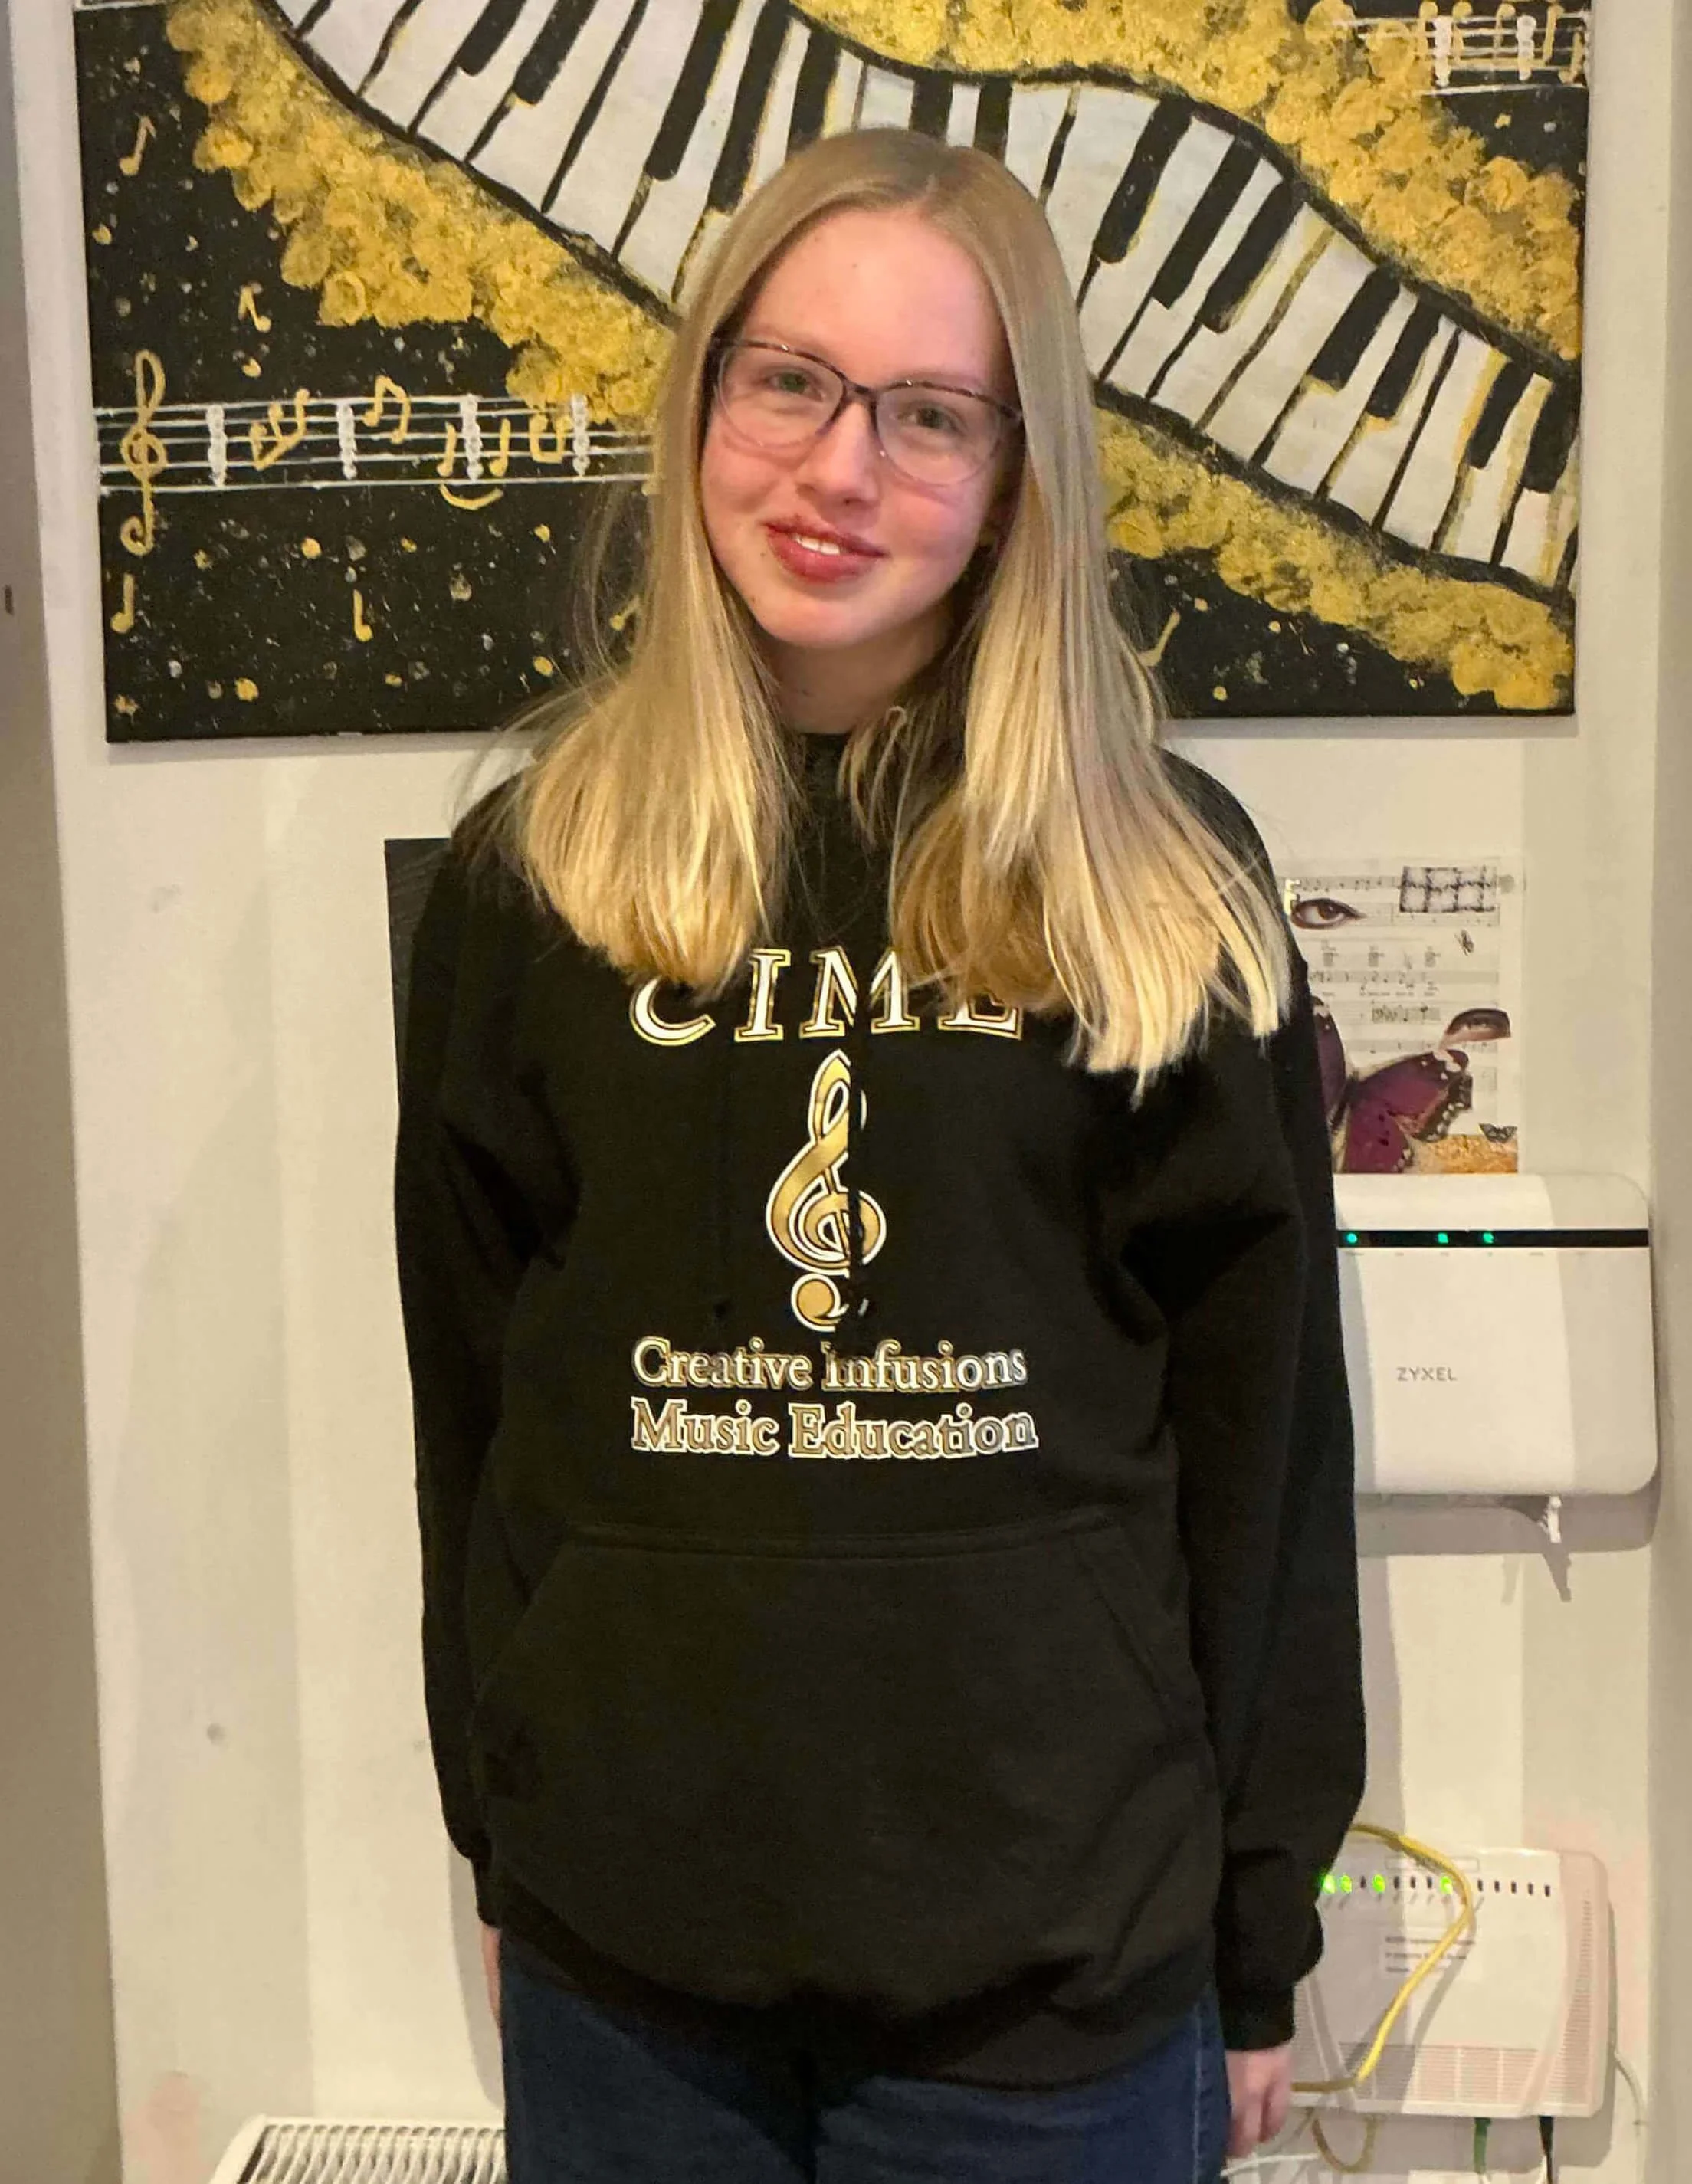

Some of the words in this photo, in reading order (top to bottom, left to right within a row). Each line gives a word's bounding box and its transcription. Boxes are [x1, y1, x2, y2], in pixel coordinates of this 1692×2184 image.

[631, 1336, 813, 1389] Creative
[1396, 1366, 1458, 1382] ZYXEL
[631, 1396, 779, 1455] Music
[788, 1400, 1039, 1461] Education
